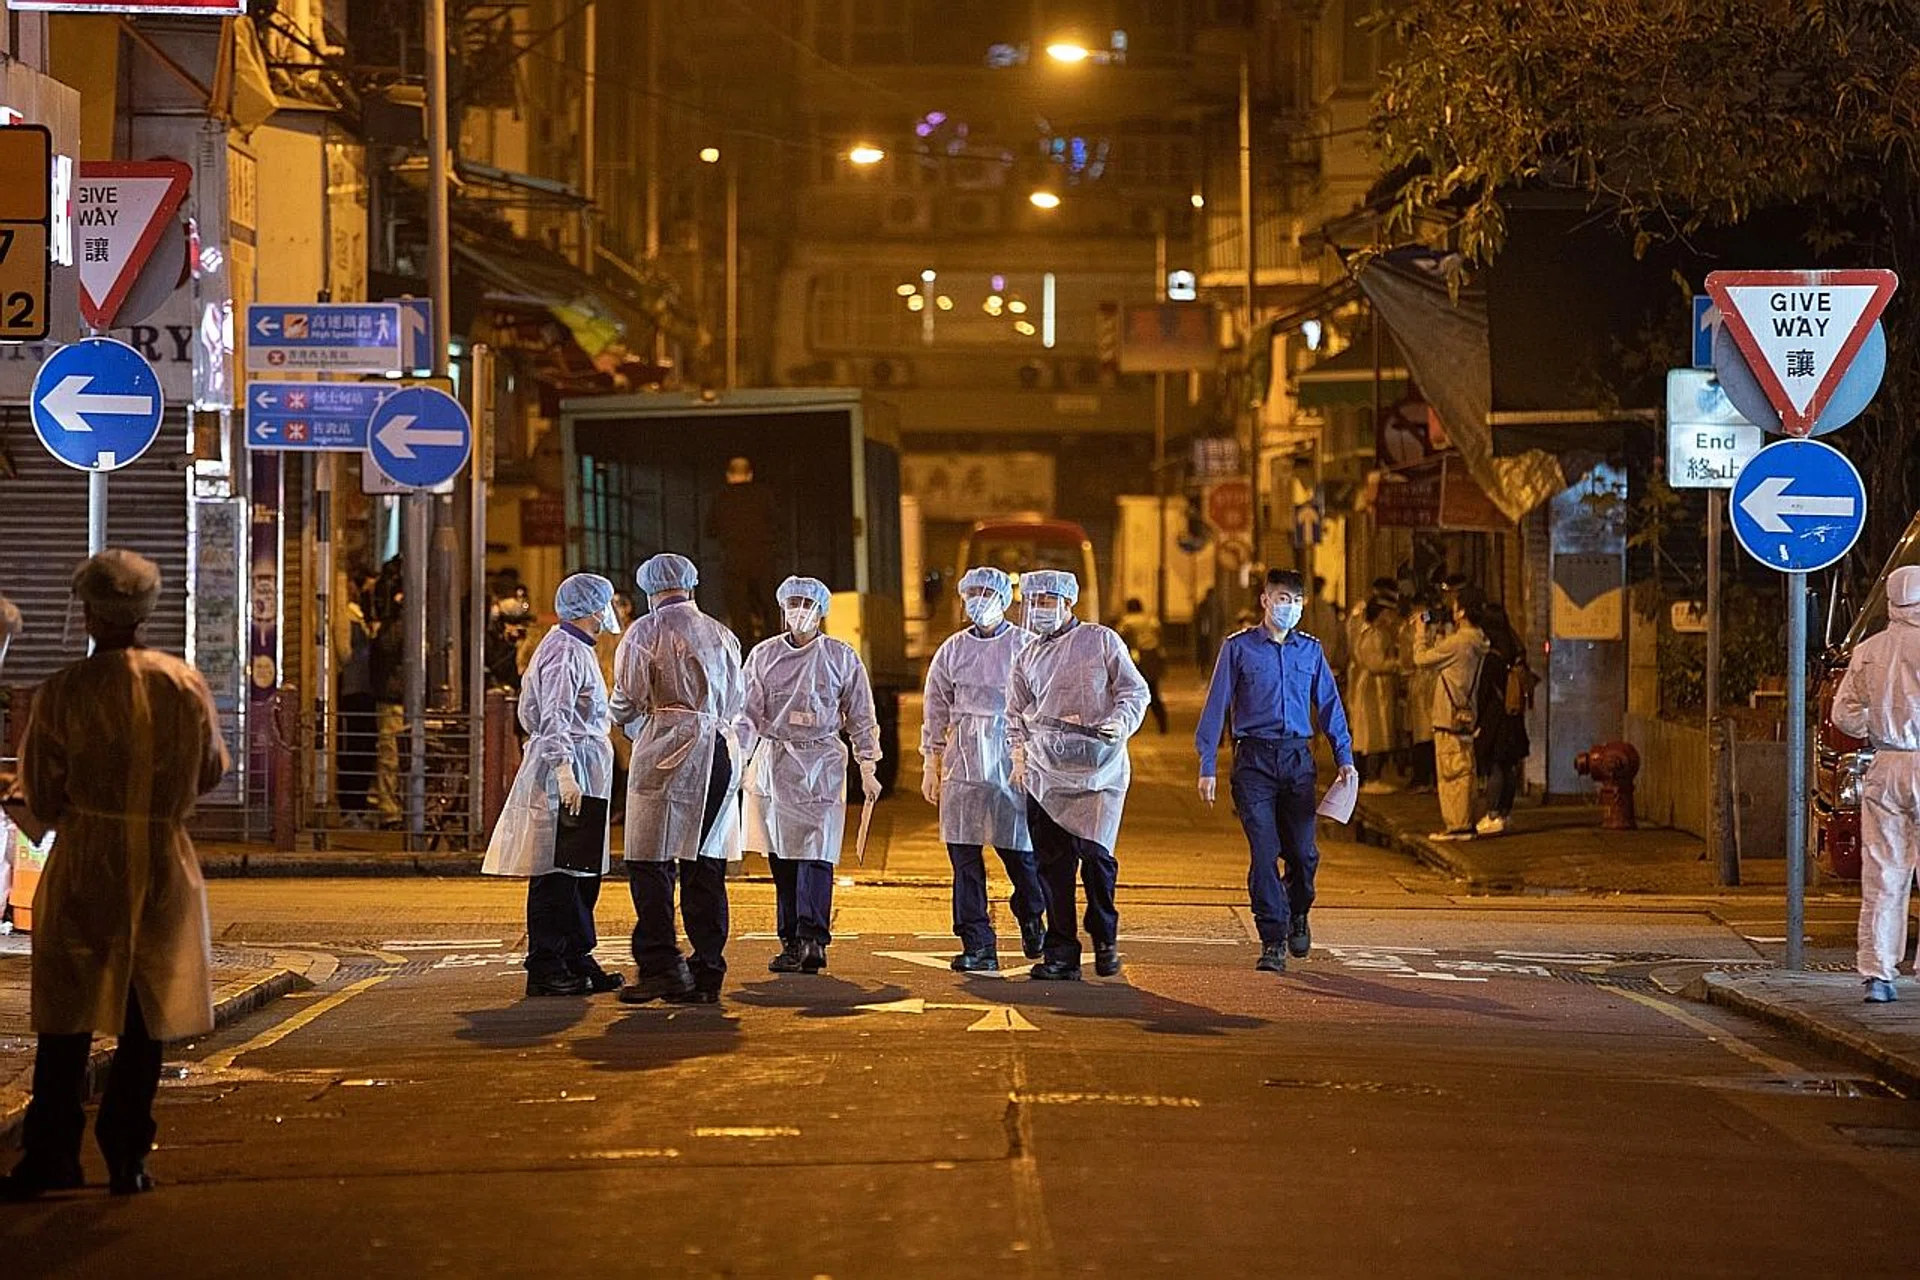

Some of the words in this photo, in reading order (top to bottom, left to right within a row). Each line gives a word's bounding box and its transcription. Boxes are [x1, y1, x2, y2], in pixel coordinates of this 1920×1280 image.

[79, 187, 117, 203] GIVE
[79, 209, 118, 226] WAY
[85, 237, 109, 262] 讓
[1770, 293, 1831, 311] GIVE
[1772, 317, 1830, 337] WAY
[1785, 348, 1815, 378] 讓
[1696, 432, 1736, 449] End
[1686, 457, 1740, 481] 終止
